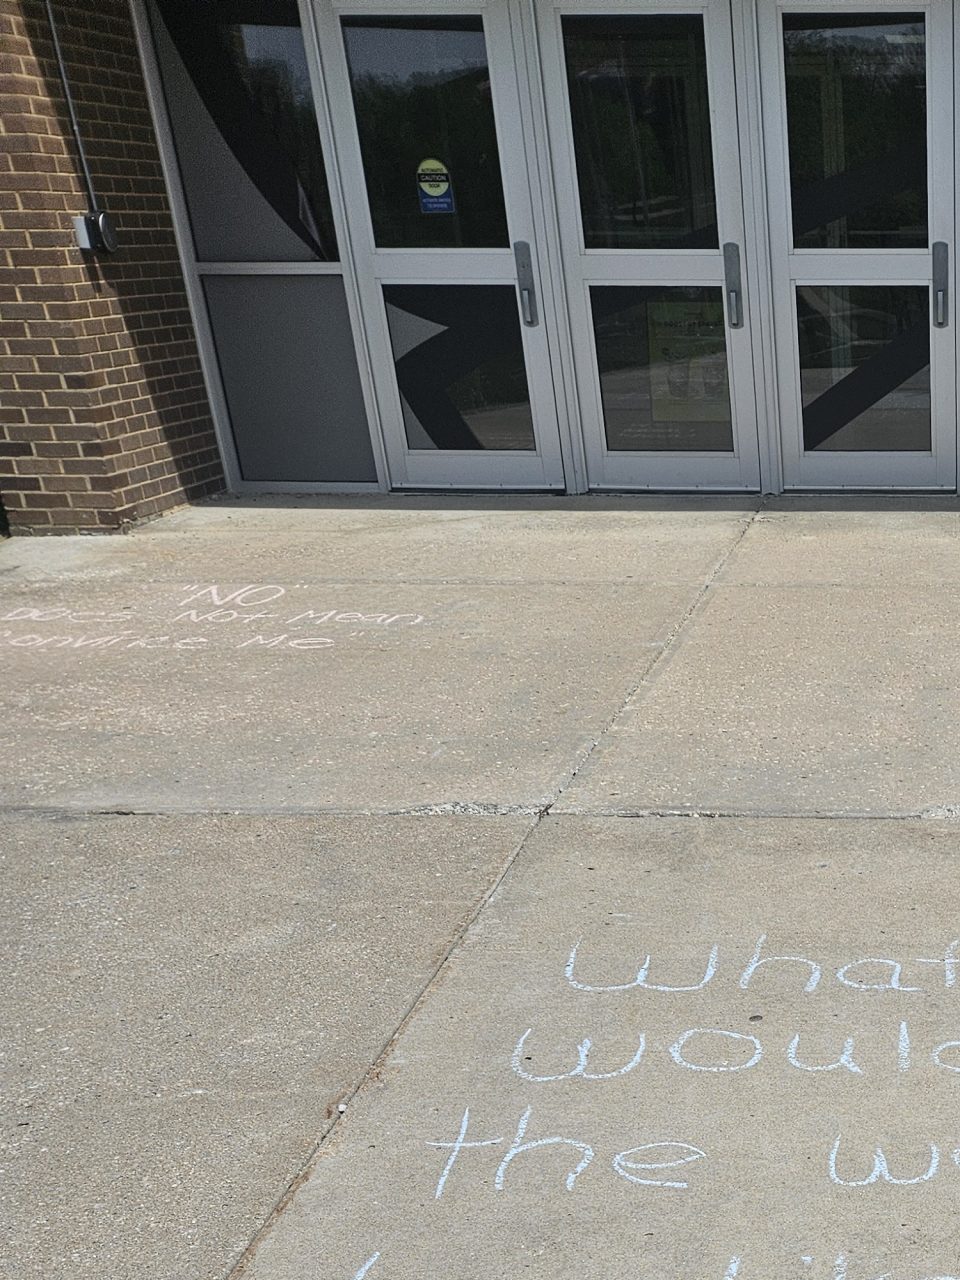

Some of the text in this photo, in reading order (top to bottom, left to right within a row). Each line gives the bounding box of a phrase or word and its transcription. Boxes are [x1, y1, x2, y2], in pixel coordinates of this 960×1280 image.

[420, 174, 447, 182] CAUTION
[285, 609, 424, 624] Mean
[1, 630, 209, 650] onvince
[425, 1104, 708, 1199] the
